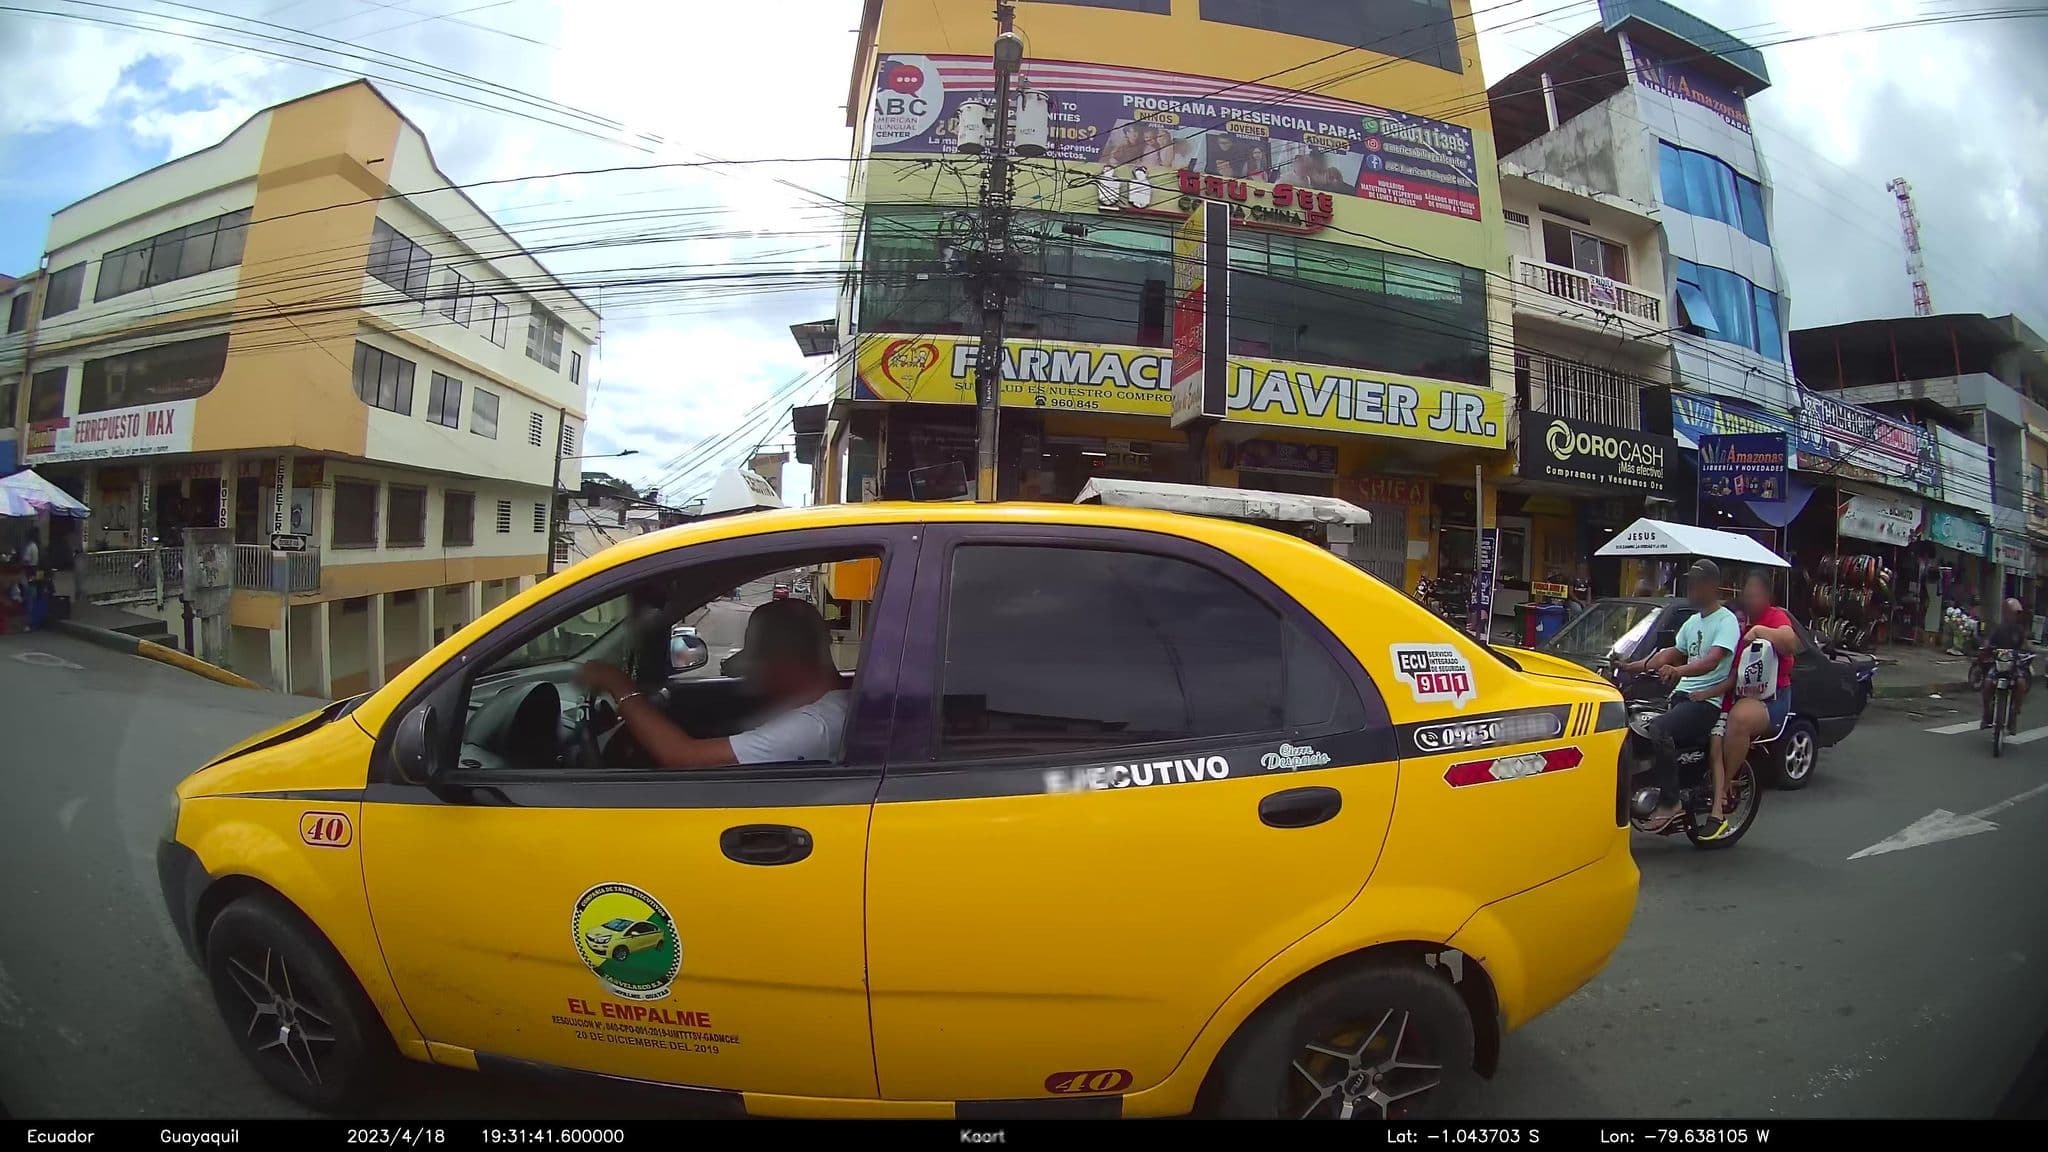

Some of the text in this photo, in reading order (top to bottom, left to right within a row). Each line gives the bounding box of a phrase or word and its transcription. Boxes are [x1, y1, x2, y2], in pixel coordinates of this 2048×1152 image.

[1062, 102, 1077, 111] TO
[1123, 95, 1361, 141] PROGRAMA PRESENCIAL PARA:
[1250, 204, 1300, 225] CHINA
[1028, 386, 1046, 396] ES
[1049, 388, 1113, 400] NUESTRO
[1116, 391, 1174, 404] COMPRO
[1051, 397, 1099, 410] 960 845
[1227, 368, 1418, 427] JAVIER
[1428, 390, 1497, 437] JR.
[75, 413, 141, 443] FERREPUESTO
[145, 409, 175, 437] MAX
[1728, 444, 1784, 464] Amazonas
[1546, 465, 1663, 490] Compramos y Vendemos Oro
[1627, 532, 1656, 541] JESUS
[1401, 654, 1427, 670] ECU
[1420, 675, 1465, 692] 911
[307, 817, 344, 841] 40
[567, 998, 712, 1029] EL EMPALME
[576, 1030, 720, 1055] 20 DE DICIEMBRE DEL 2019
[1056, 1071, 1121, 1093] 40
